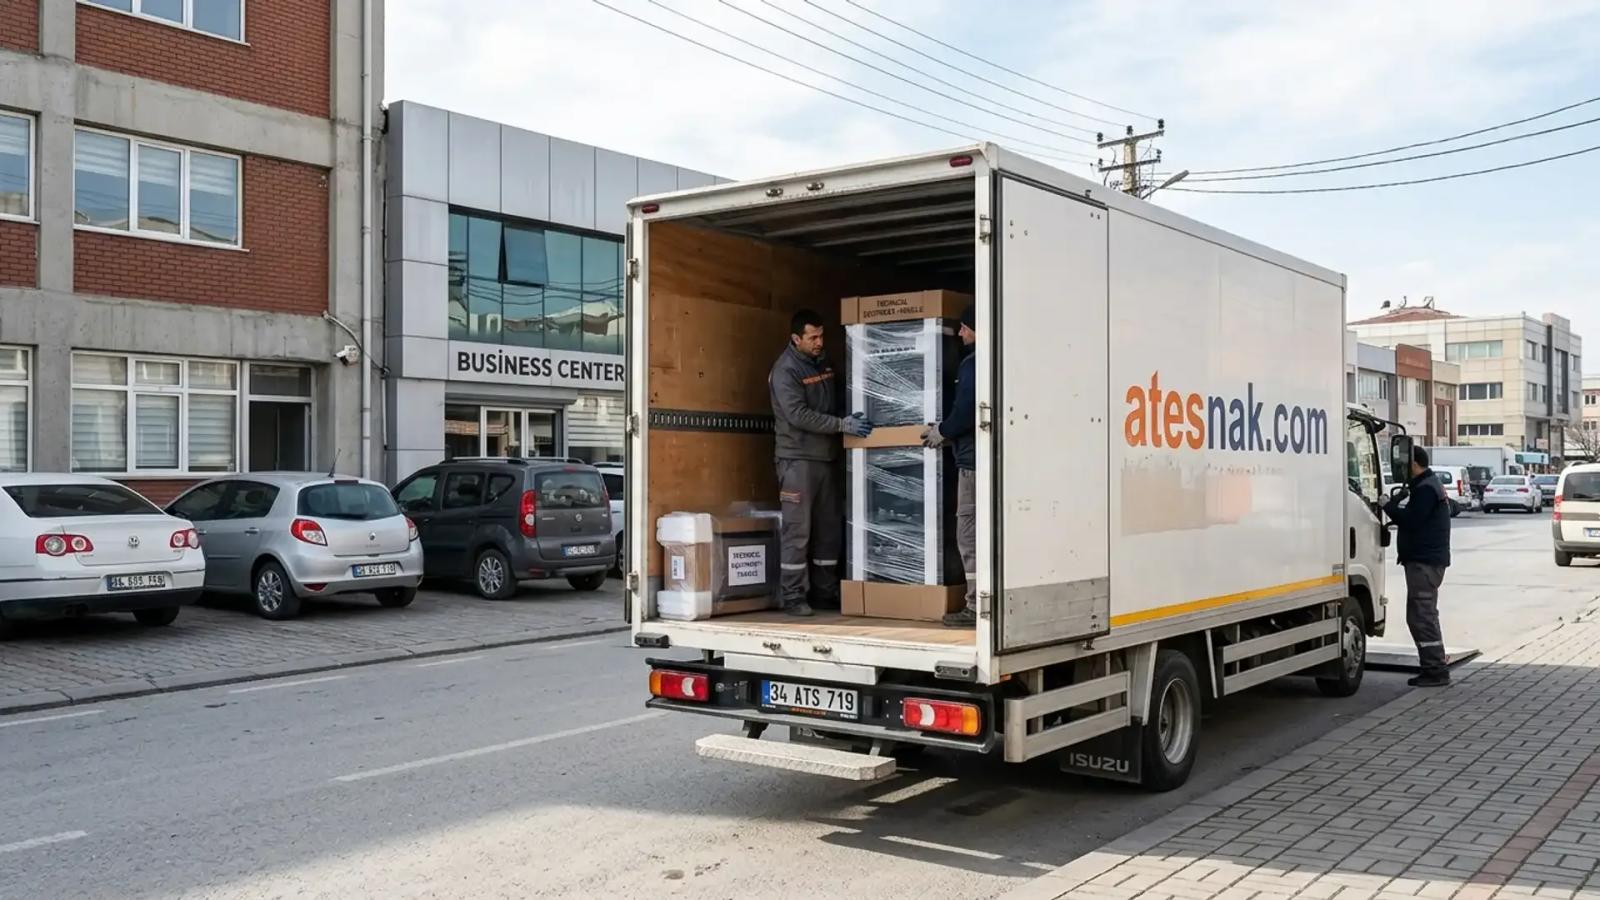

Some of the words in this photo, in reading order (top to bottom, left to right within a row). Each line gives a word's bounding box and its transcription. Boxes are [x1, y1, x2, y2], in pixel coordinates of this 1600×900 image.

[557, 360, 624, 382] CENTER
[1124, 370, 1328, 454] atesnak.com
[770, 684, 787, 703] 34
[794, 686, 820, 707] ATS
[827, 690, 854, 711] 719
[1070, 752, 1129, 773] ISUZU
